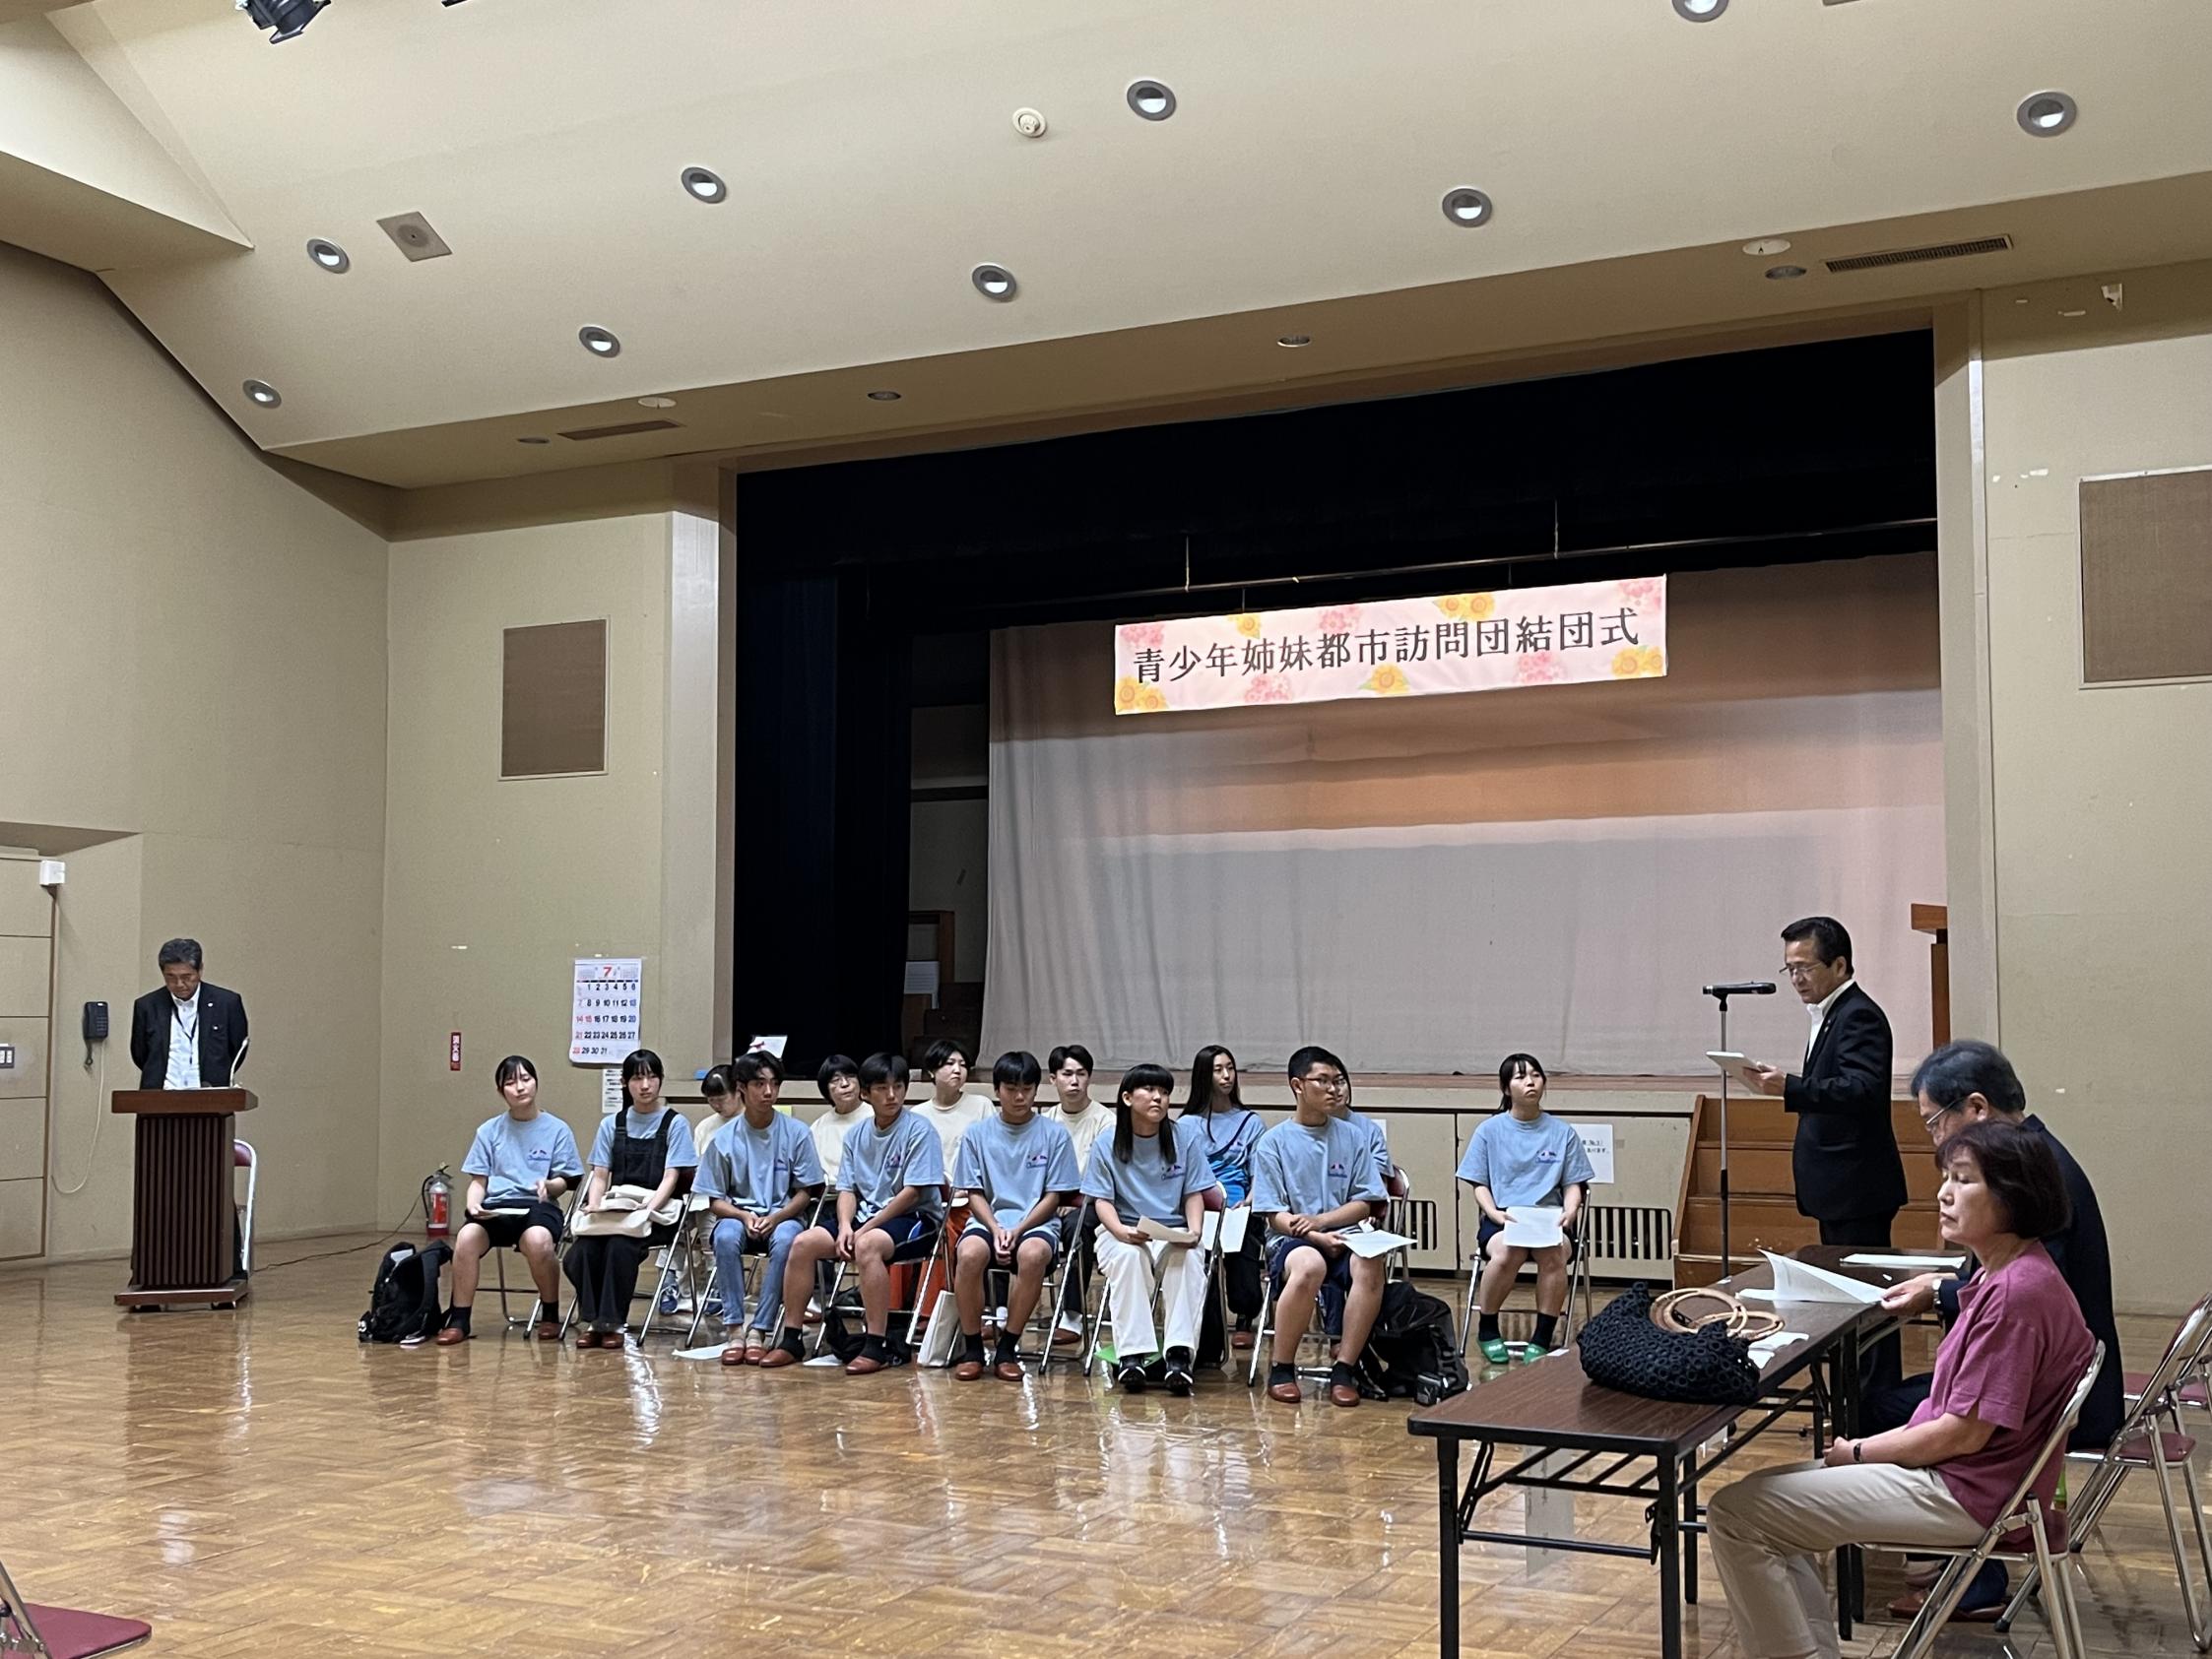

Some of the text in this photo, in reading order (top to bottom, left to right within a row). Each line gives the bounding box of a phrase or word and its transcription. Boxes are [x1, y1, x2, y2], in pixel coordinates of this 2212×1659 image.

[1134, 606, 1640, 683] 青少年姉妹都市訪問団結団式
[603, 967, 613, 977] 7
